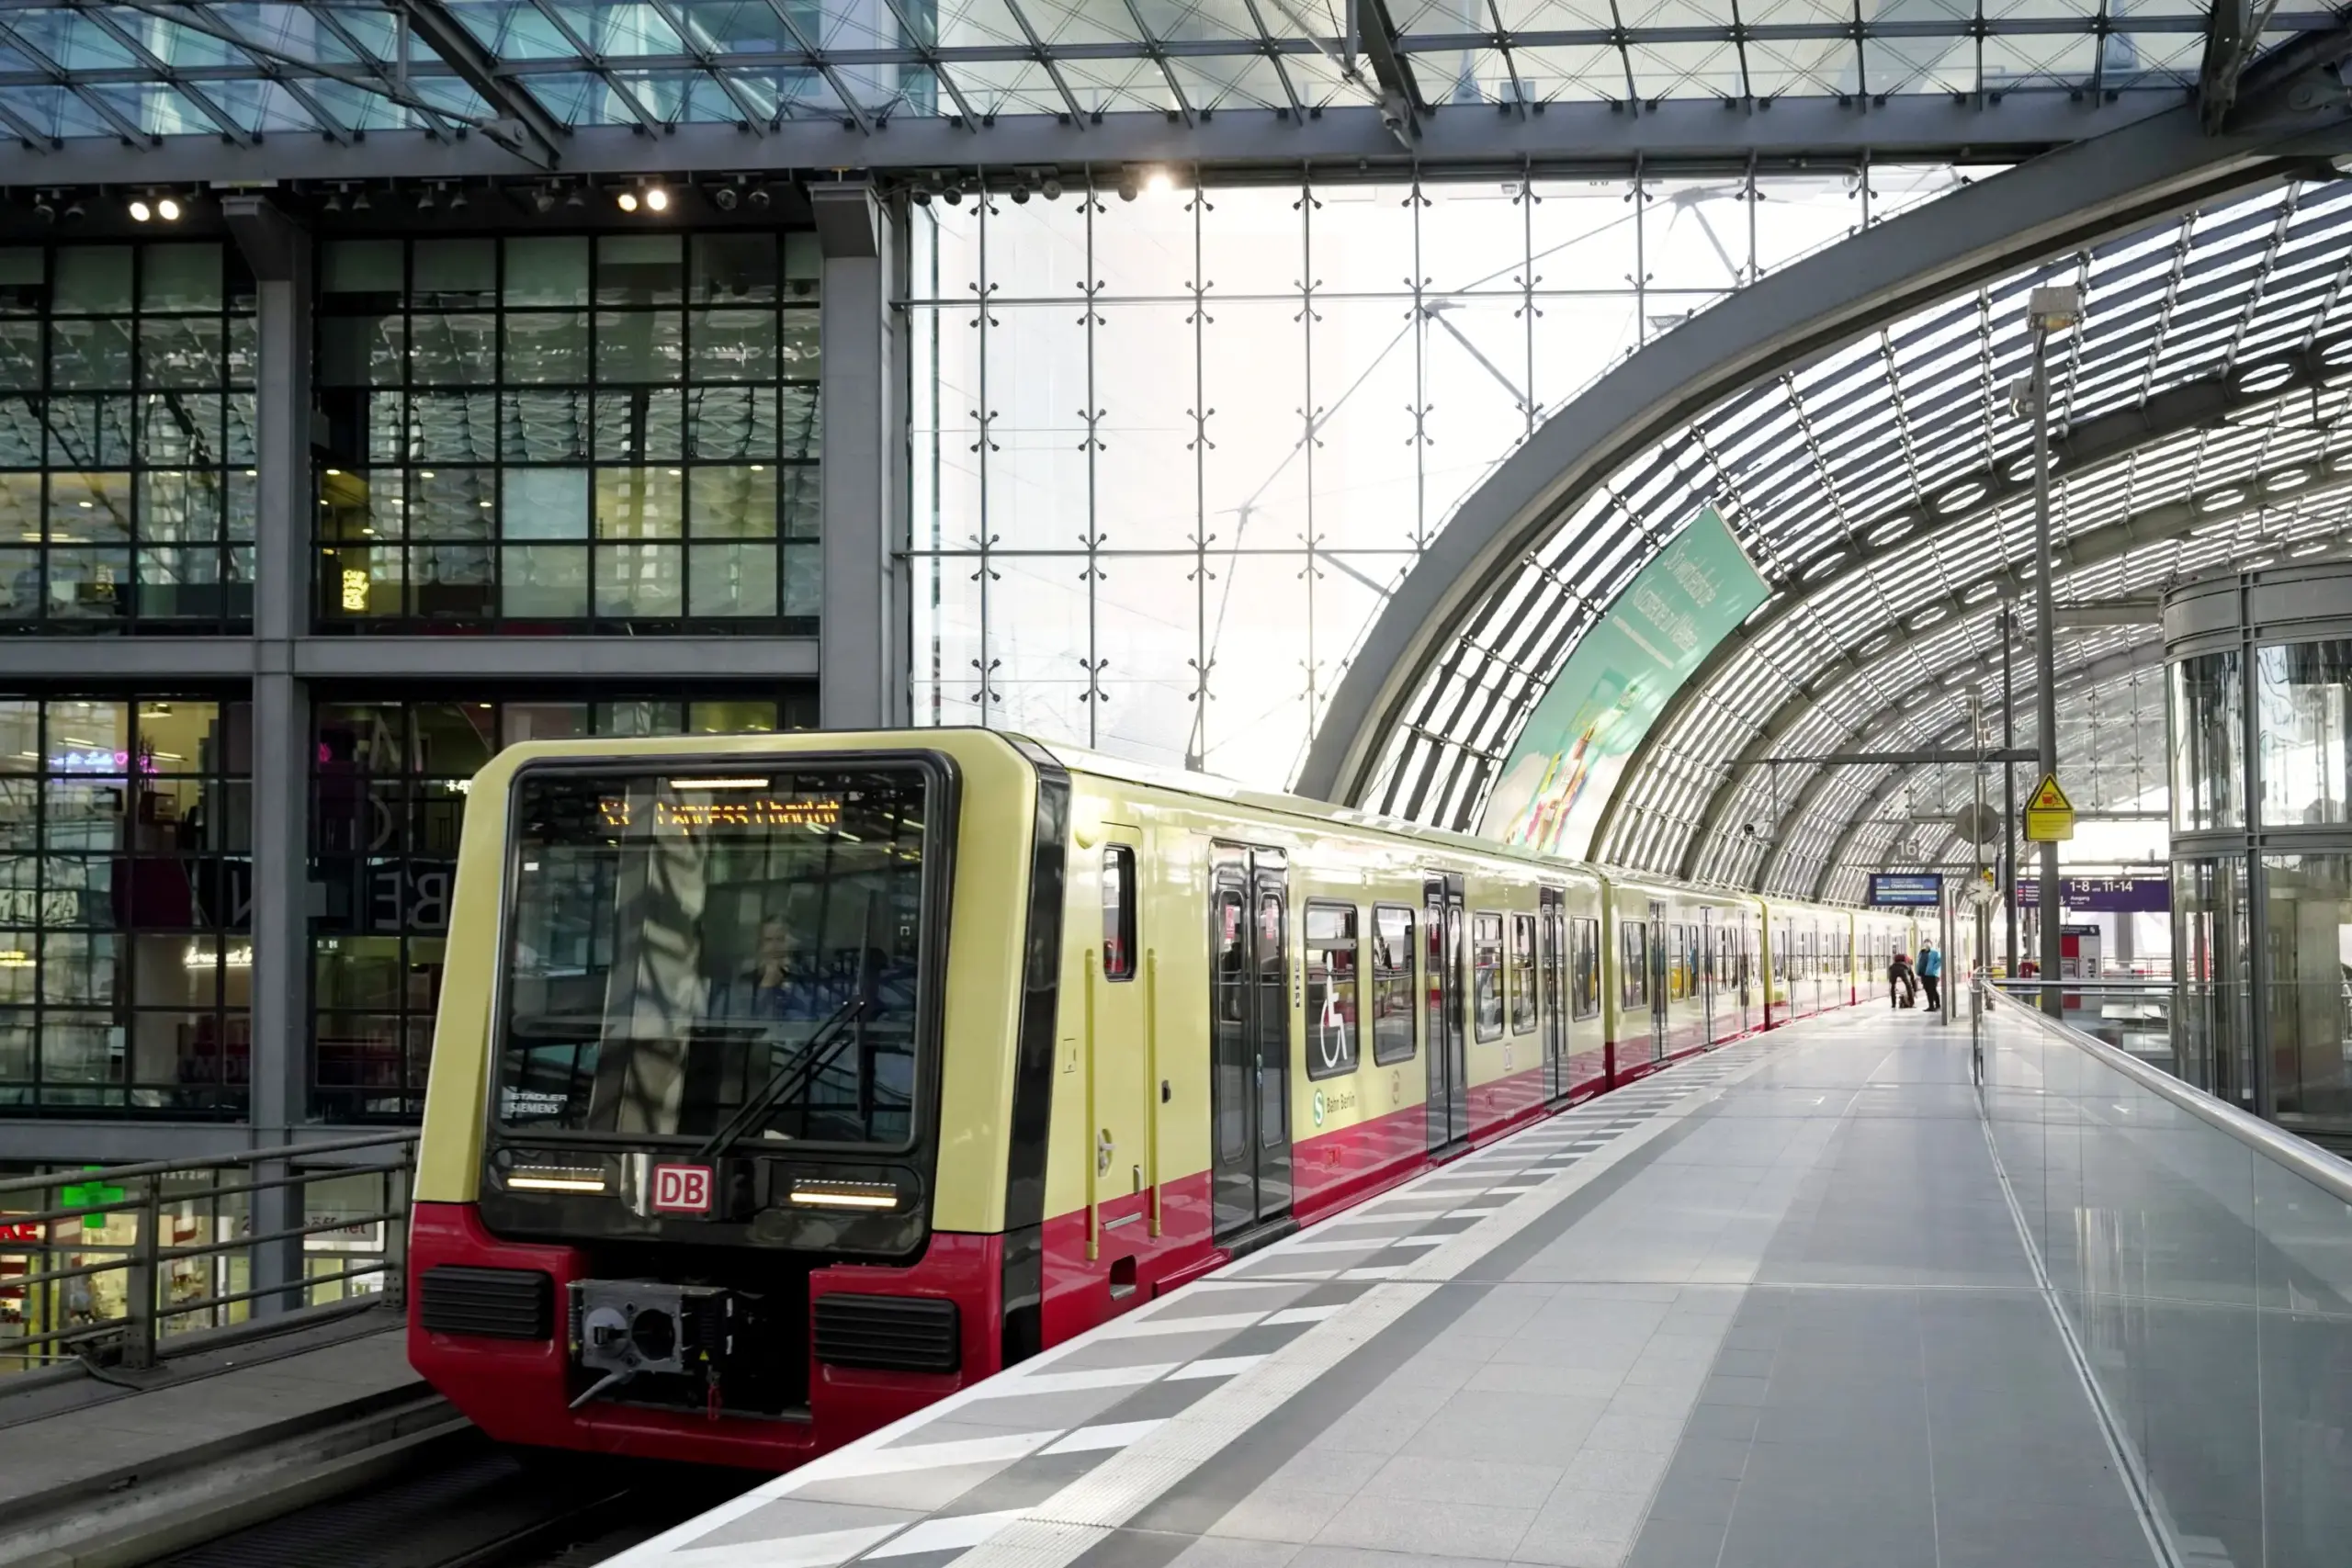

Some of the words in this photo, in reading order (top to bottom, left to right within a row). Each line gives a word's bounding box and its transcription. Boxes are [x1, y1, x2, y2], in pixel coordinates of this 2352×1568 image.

[1896, 840, 1917, 856] 16
[2069, 881, 2090, 892] 1-8
[2102, 881, 2133, 892] 11-14
[512, 1093, 568, 1101] STADLER
[510, 1102, 559, 1113] SIEMENS
[660, 1171, 705, 1204] DB
